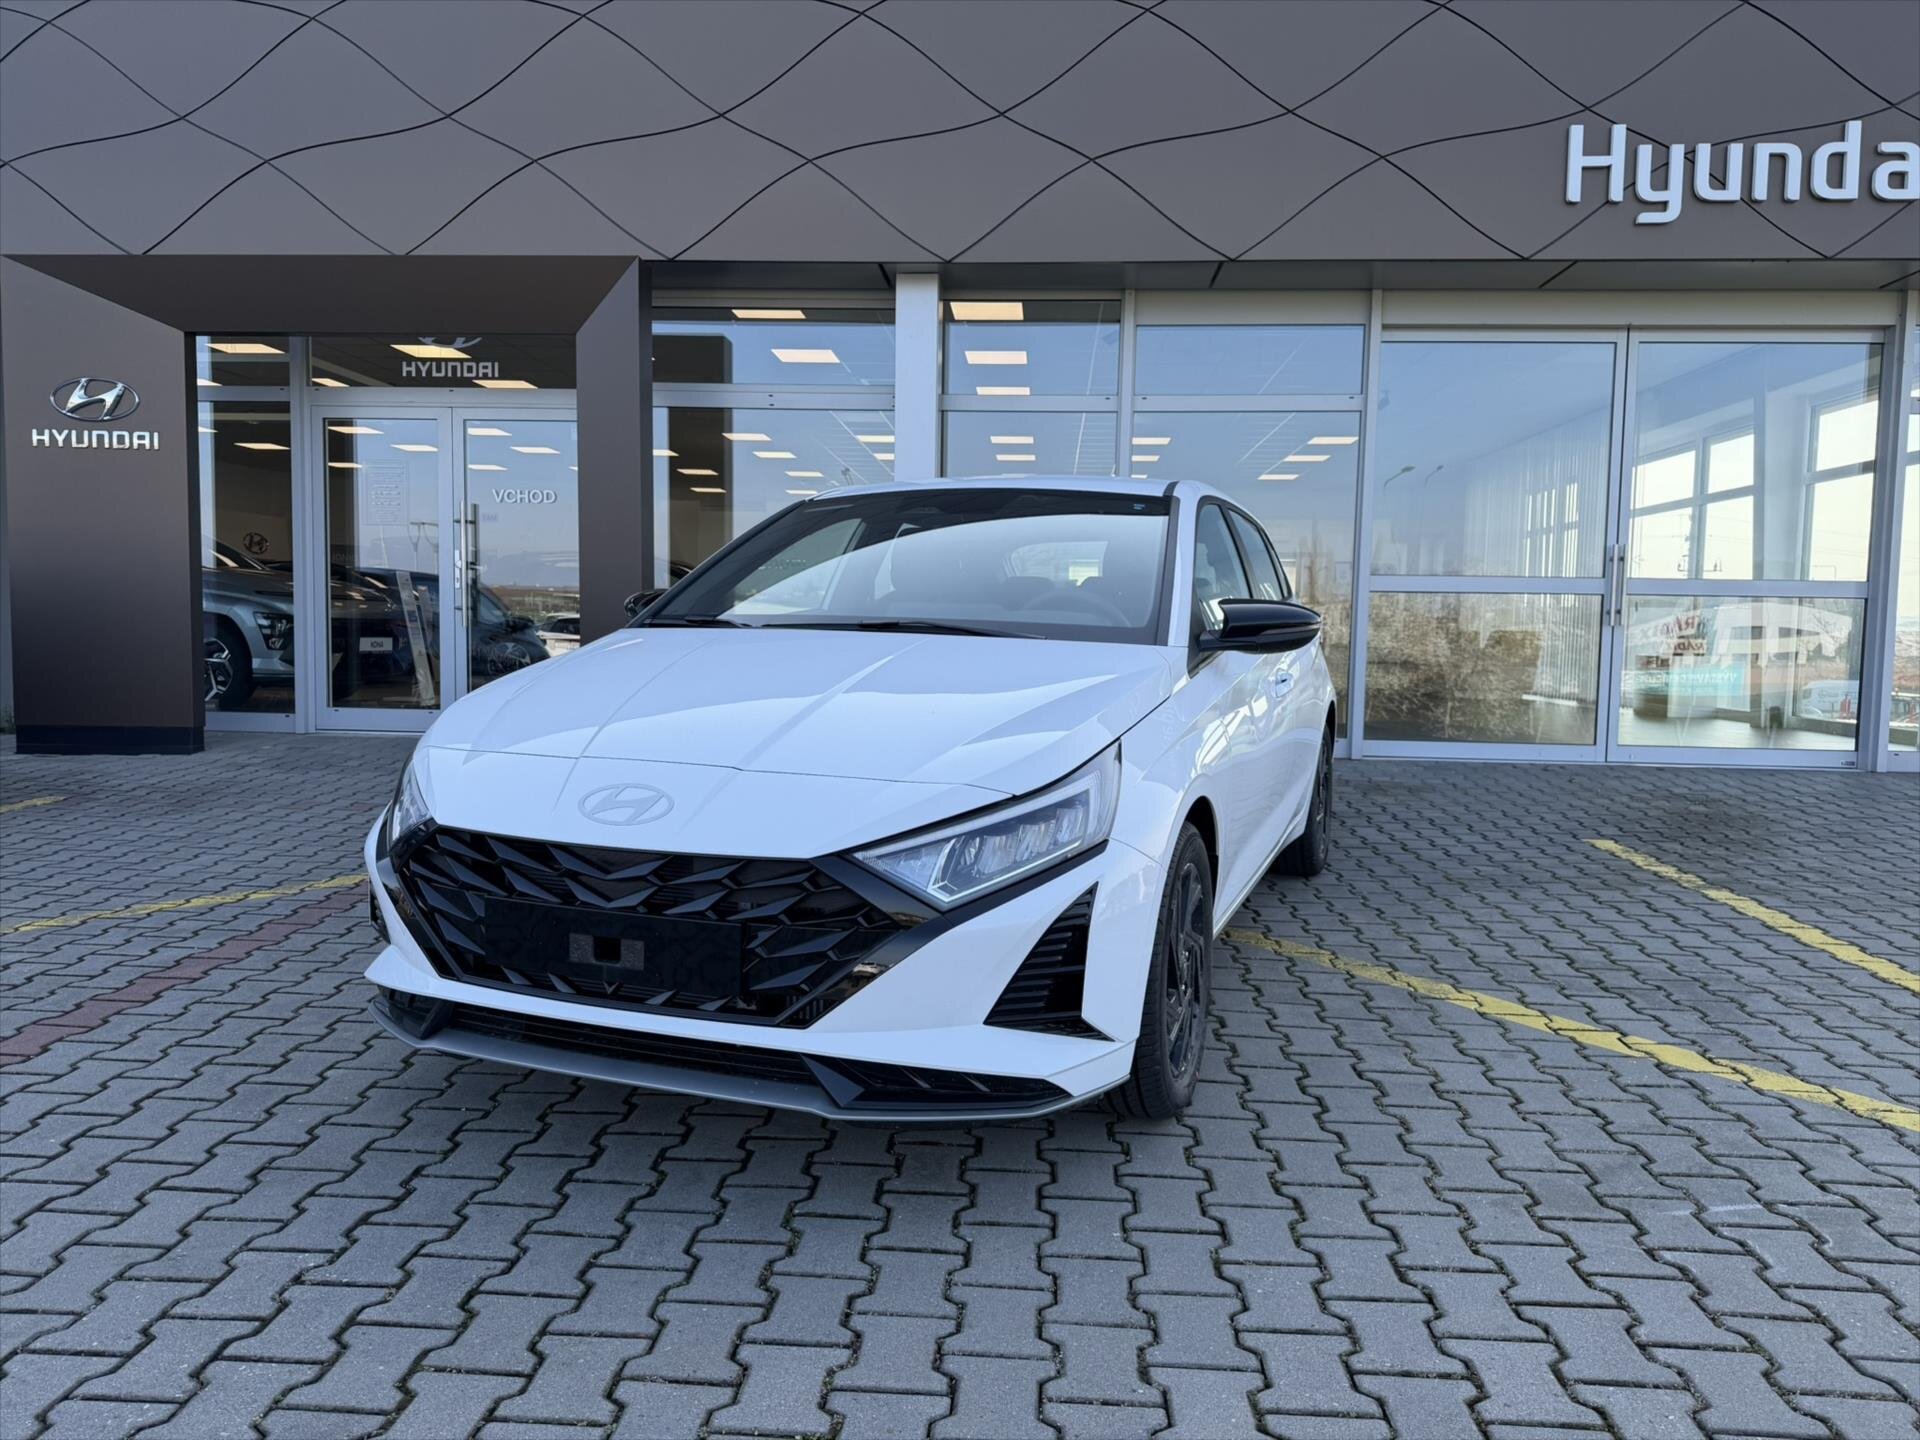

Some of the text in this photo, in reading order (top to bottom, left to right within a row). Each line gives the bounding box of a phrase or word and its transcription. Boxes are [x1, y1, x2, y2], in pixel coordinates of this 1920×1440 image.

[1566, 120, 1920, 225] Hyunda
[402, 360, 499, 379] HYUNDAI
[31, 428, 161, 451] HYUNDAI
[492, 488, 557, 505] VCHOD
